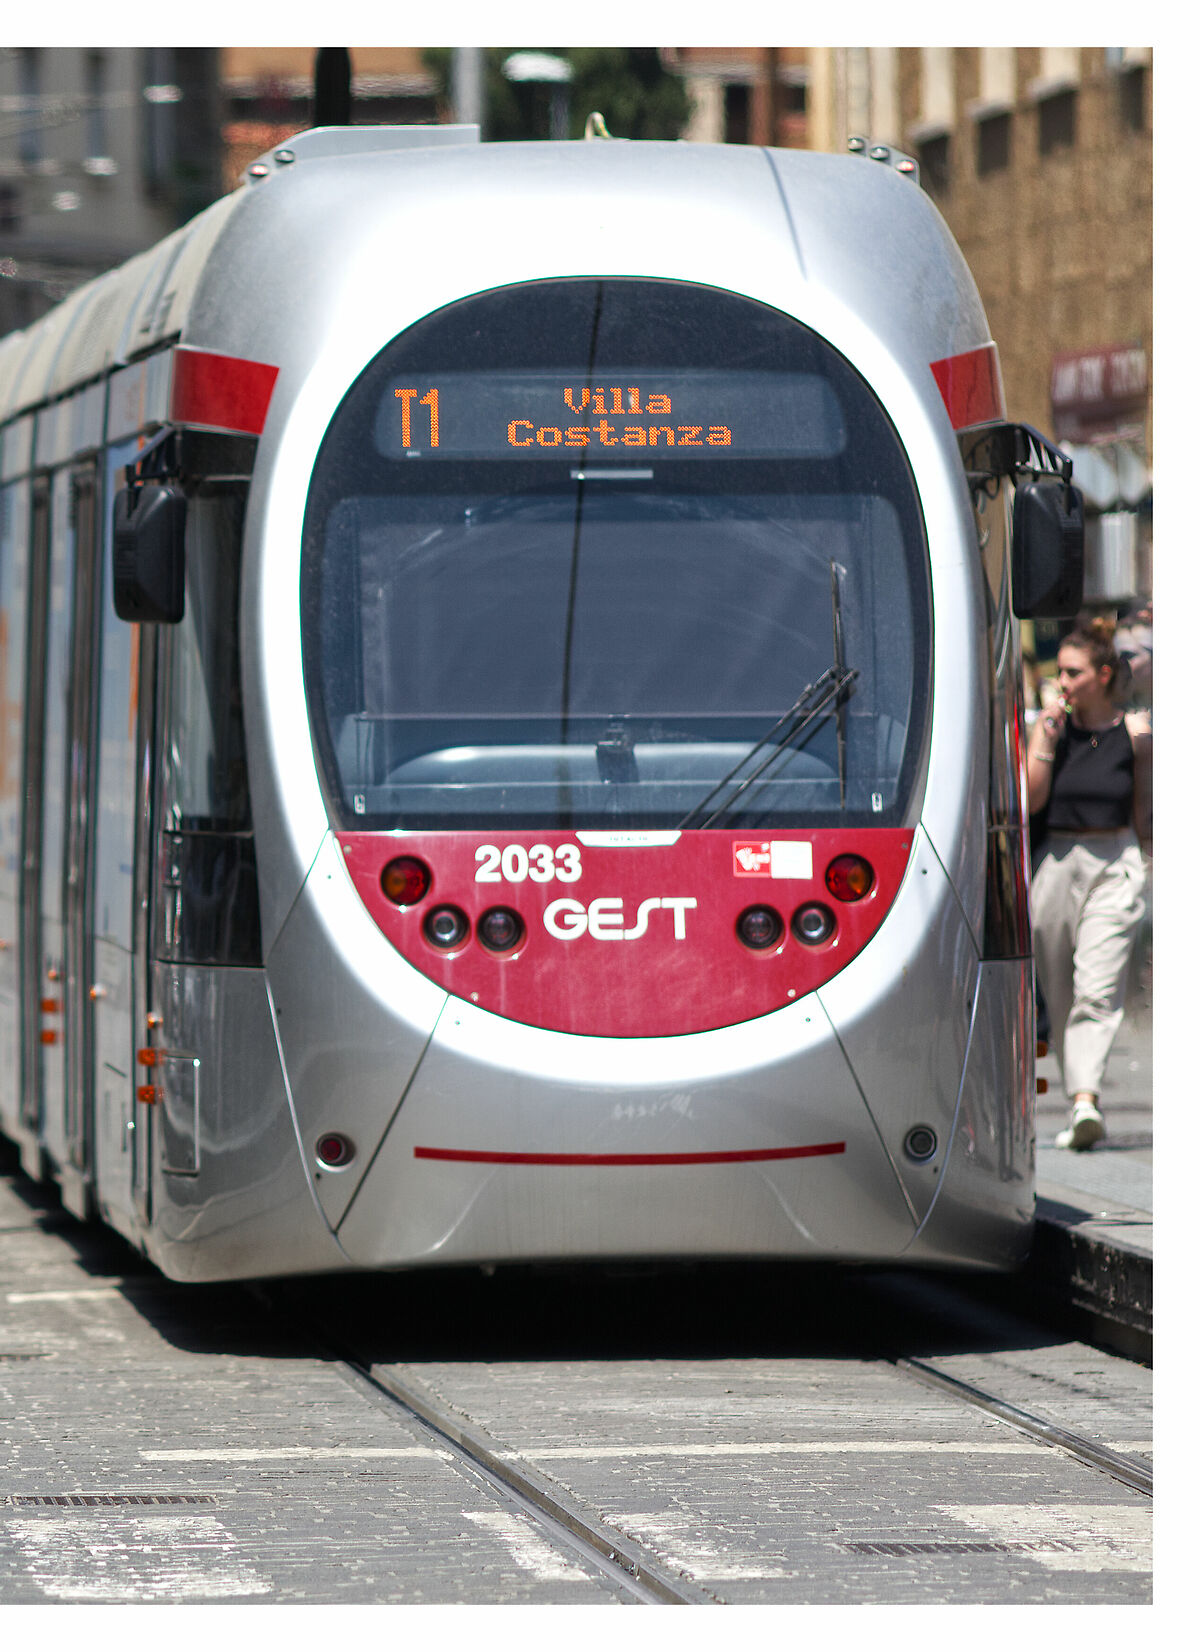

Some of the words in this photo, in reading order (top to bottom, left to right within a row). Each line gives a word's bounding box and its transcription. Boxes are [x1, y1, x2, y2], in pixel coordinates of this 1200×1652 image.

[394, 388, 440, 448] T1
[563, 387, 672, 415] Villa
[507, 419, 732, 447] Costanza
[474, 843, 583, 883] 2033
[543, 897, 698, 941] GEST
